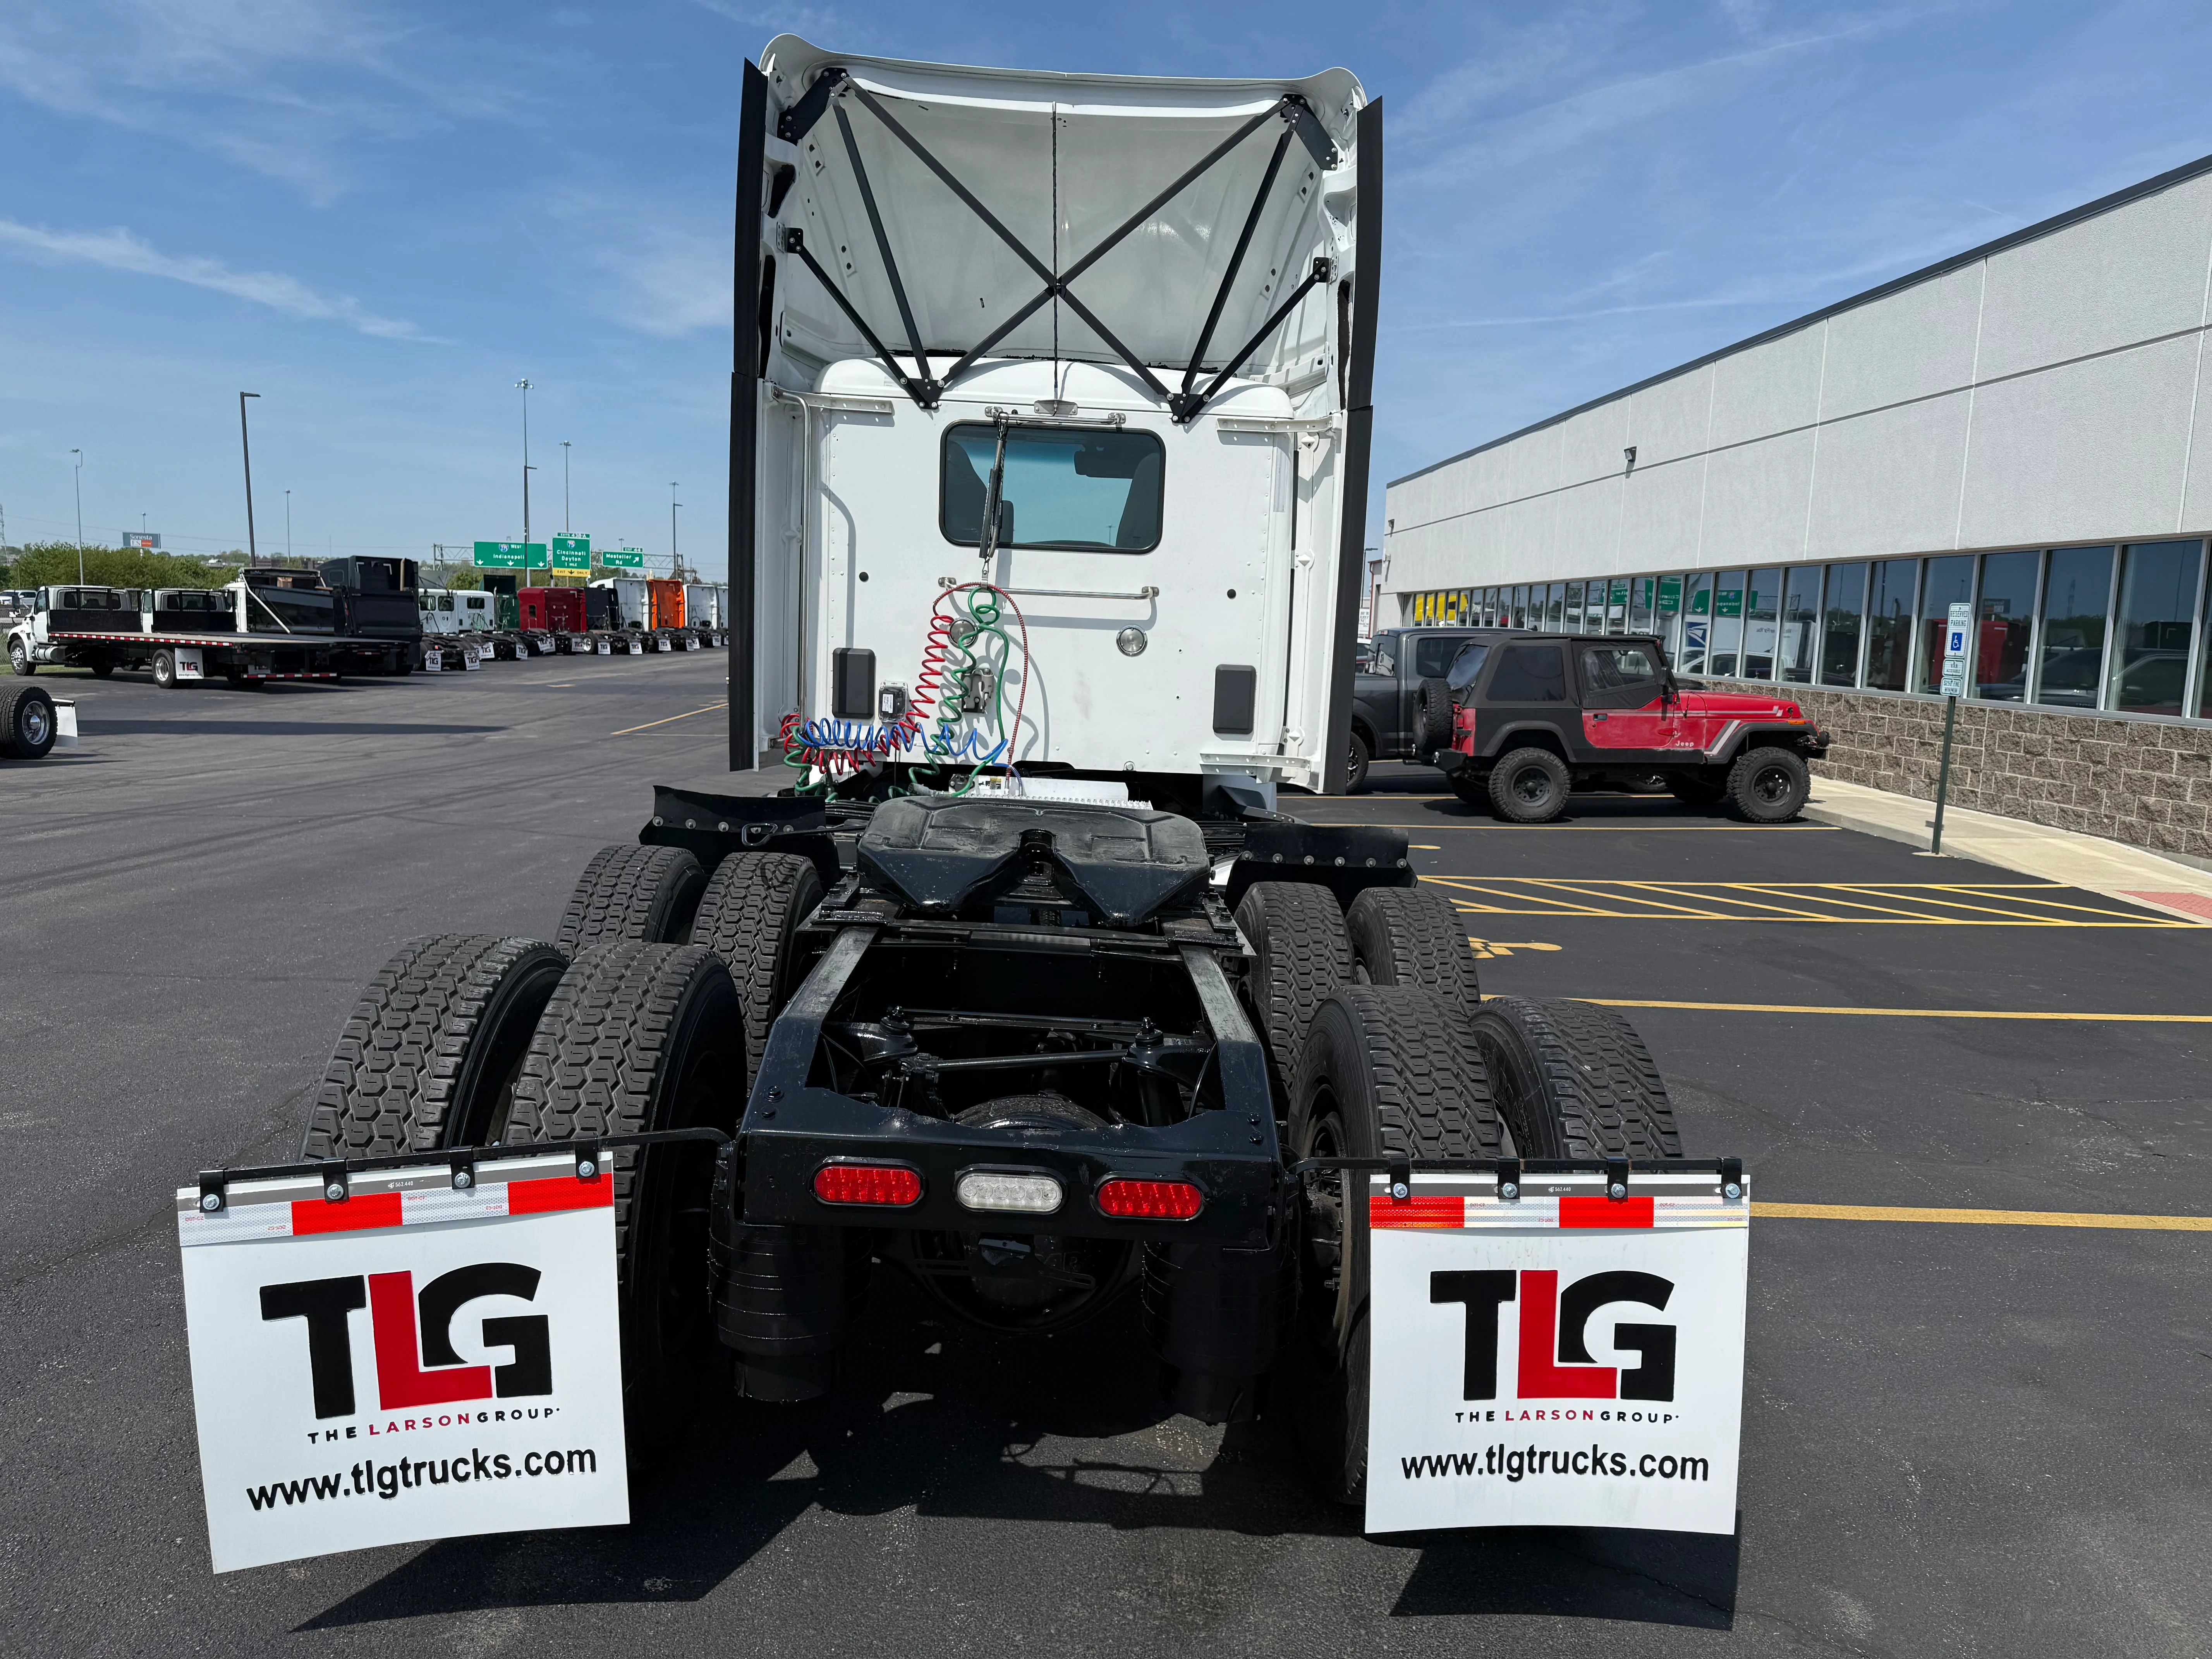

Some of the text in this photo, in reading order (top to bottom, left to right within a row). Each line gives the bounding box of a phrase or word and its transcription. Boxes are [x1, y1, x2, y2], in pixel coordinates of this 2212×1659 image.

[180, 662, 198, 672] TLG
[259, 1262, 553, 1420] TLG
[1430, 1270, 1676, 1401] TLG
[308, 1426, 357, 1444] THE
[1455, 1411, 1495, 1423] THE
[247, 1448, 596, 1511] www.tlgtrucks.com
[1401, 1444, 1709, 1482] www.tlgtrucks.com
